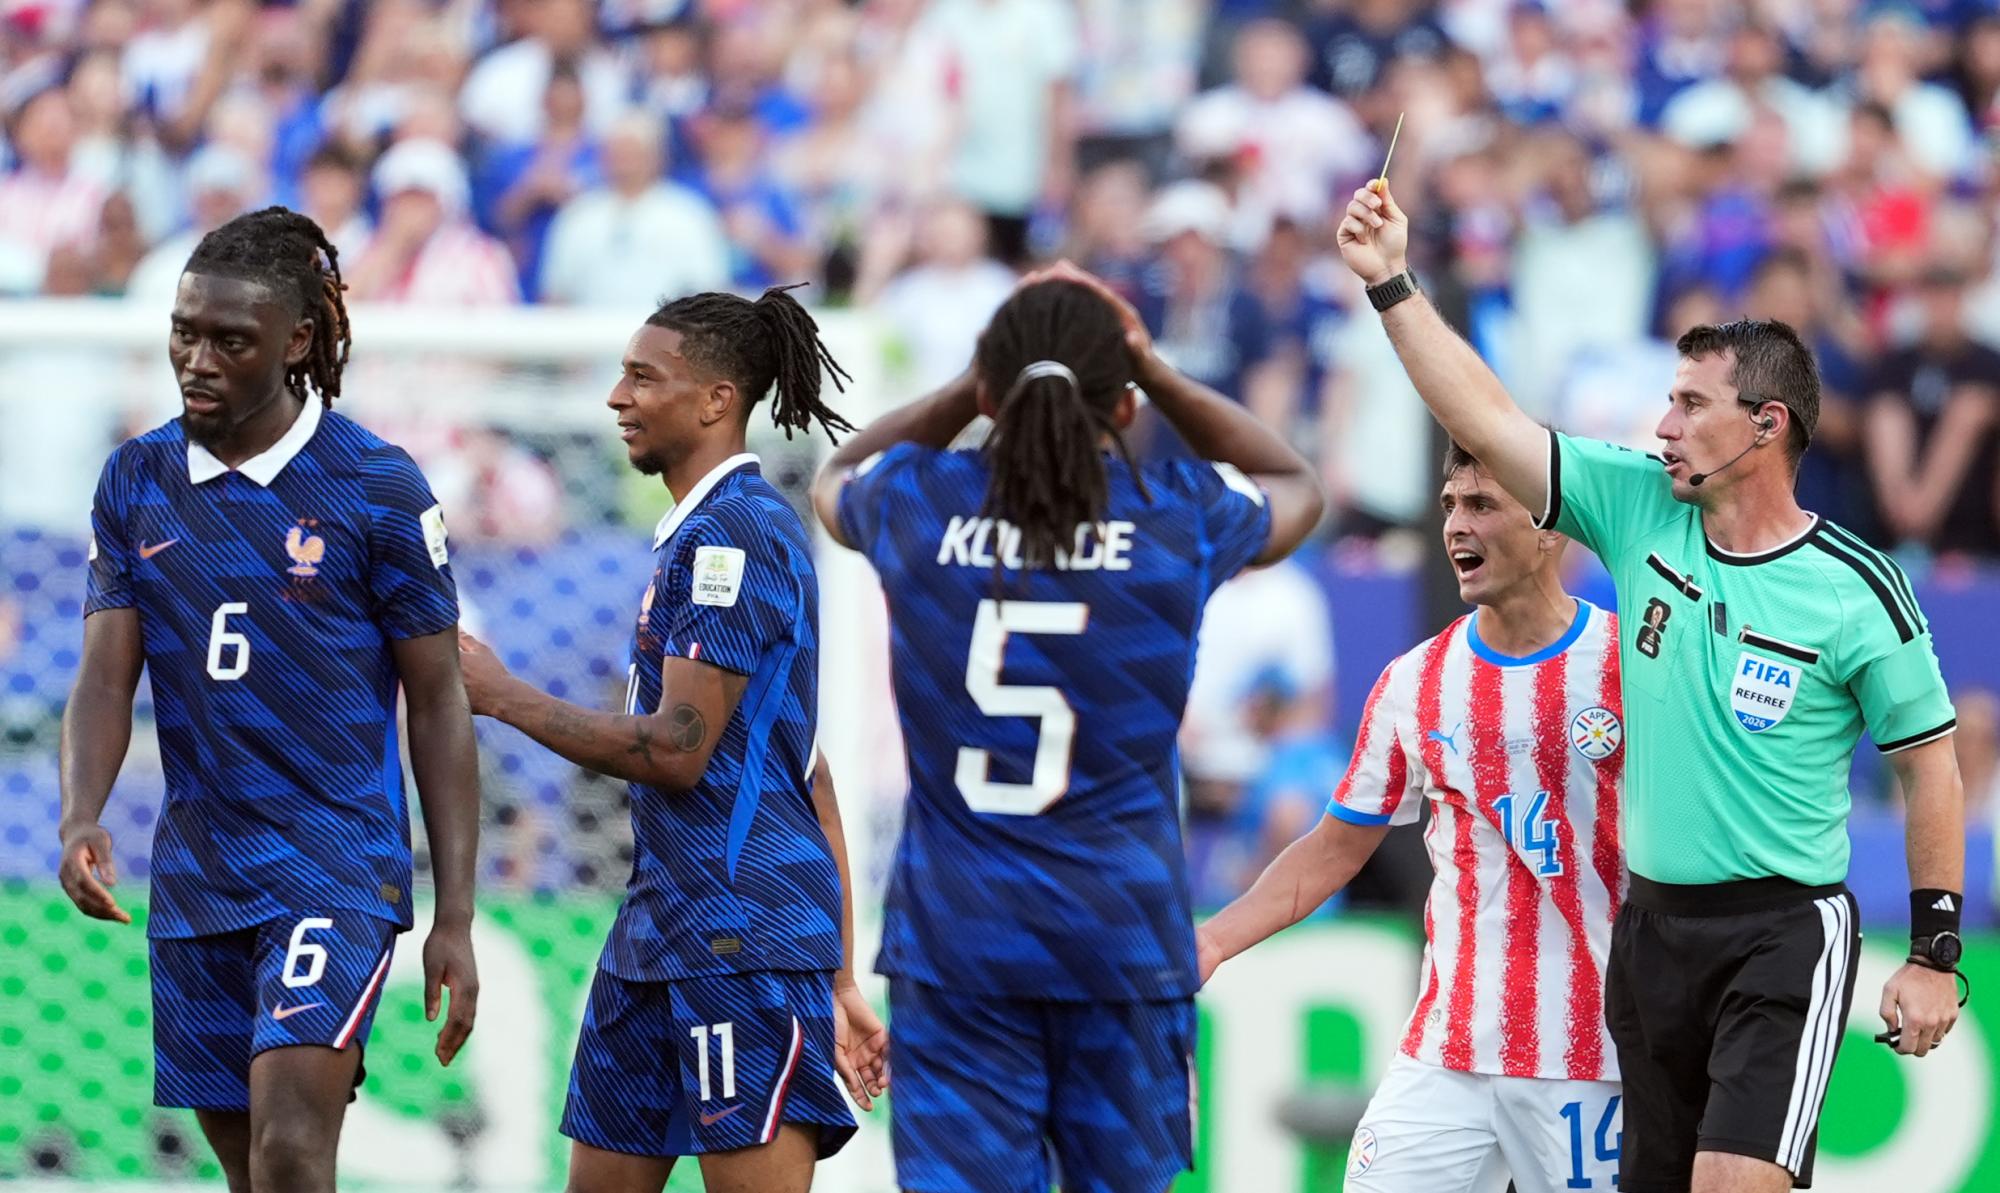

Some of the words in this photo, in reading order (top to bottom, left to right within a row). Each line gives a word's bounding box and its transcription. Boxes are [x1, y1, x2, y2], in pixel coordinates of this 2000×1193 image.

[699, 583, 731, 593] EDUCATION
[206, 602, 250, 681] 6
[1742, 659, 1791, 688] FIFA
[954, 599, 1090, 816] 5
[1588, 711, 1607, 720] APF
[1735, 687, 1787, 709] REFEREE
[1742, 714, 1767, 728] 2026
[1491, 791, 1564, 878] 14
[281, 917, 334, 989] 6
[690, 1022, 736, 1101] 11
[1559, 1094, 1623, 1193] 14
